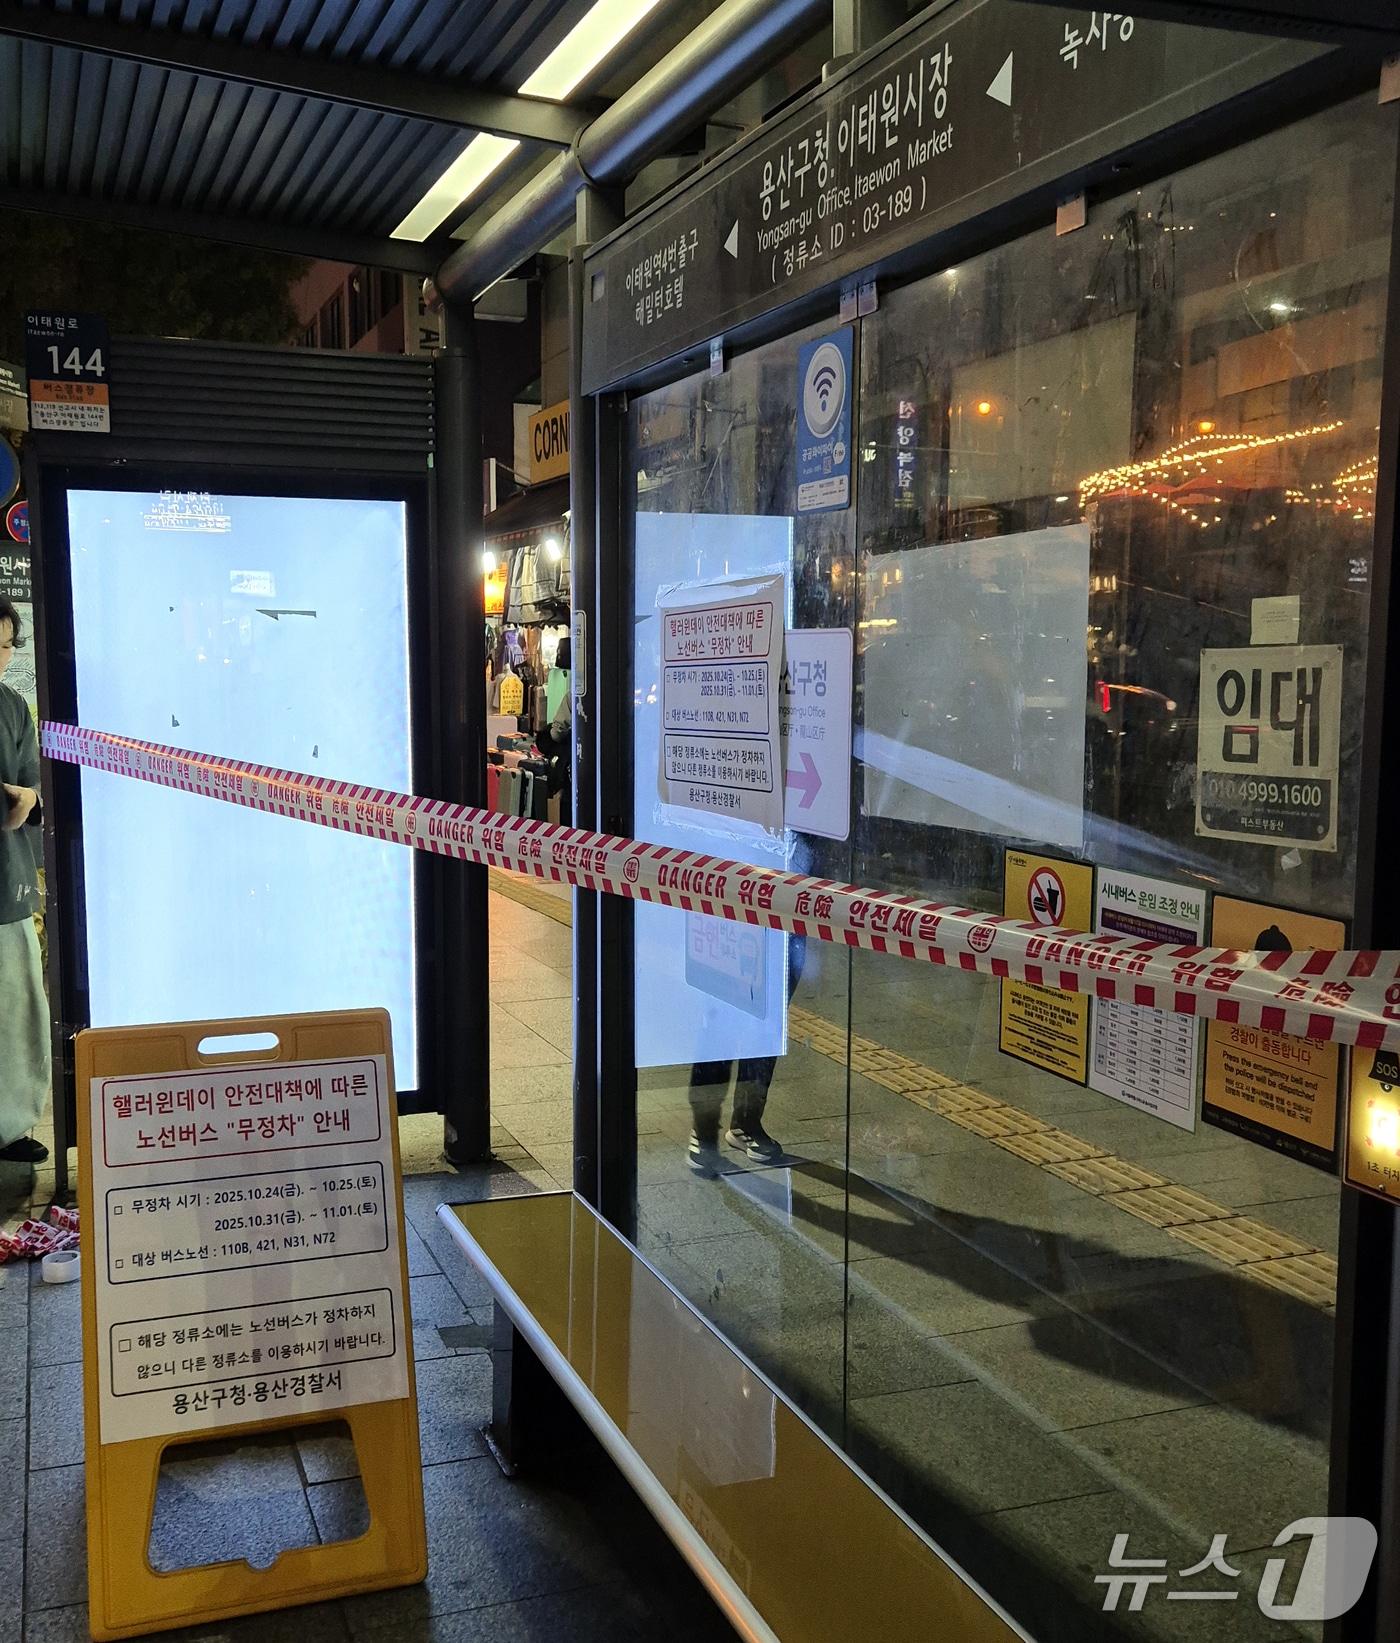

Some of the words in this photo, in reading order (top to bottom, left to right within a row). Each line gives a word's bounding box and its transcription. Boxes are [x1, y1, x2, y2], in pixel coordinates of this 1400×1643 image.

[756, 207, 813, 253] Yongsan-gu
[907, 123, 954, 171] Market
[783, 234, 823, 277] 정류소
[830, 222, 844, 250] ID
[863, 185, 912, 234] 03-189
[625, 228, 699, 296] 이태원역4번출구
[635, 273, 684, 327] 해밀턴호텔
[27, 315, 79, 330] 이태원로
[47, 346, 105, 377] 144
[746, 609, 764, 630] 따른
[677, 639, 705, 657] 노선버스
[737, 633, 754, 654] 안내
[779, 659, 827, 697] 산구청
[1216, 666, 1324, 767] 임대
[267, 787, 302, 805] DANGER
[306, 789, 324, 812] 위험
[355, 802, 396, 828] 안전제일
[428, 816, 474, 845] DANGER
[481, 828, 506, 853] 위험
[518, 835, 542, 859] 危險
[551, 841, 609, 875] 안전제일
[657, 864, 727, 899] DANGER
[738, 879, 777, 910] 위험
[794, 890, 835, 920] 危險
[848, 898, 943, 942] 안전제일
[1024, 933, 1154, 976] DANGER
[1170, 961, 1245, 992] 위험
[1273, 976, 1356, 1009] 危險
[1101, 882, 1137, 903] 시내버스
[1138, 891, 1157, 910] 운임
[1158, 896, 1178, 915] 조정
[1180, 900, 1200, 921] 안내
[1231, 1027, 1258, 1049] 경찰이
[1262, 1036, 1311, 1065] 출동합니다
[1222, 1050, 1240, 1063] Press
[1241, 1057, 1252, 1067] the
[1253, 1063, 1290, 1082] emergency
[1290, 1074, 1304, 1086] bell
[1304, 1080, 1319, 1091] and
[1224, 1062, 1235, 1073] the
[1235, 1068, 1255, 1081] police
[1255, 1074, 1267, 1084] will
[1267, 1078, 1277, 1088] be
[1376, 1061, 1398, 1079] SOS
[225, 1077, 323, 1108] 안전대책에
[331, 1073, 369, 1098] 따른
[136, 1122, 219, 1149] 노선버스
[227, 1113, 305, 1142] "무정차"
[313, 1107, 351, 1134] 안내
[1367, 1161, 1380, 1174] 1초
[131, 1196, 171, 1215] 무정차
[176, 1192, 202, 1209] 시기
[214, 1183, 305, 1205] 2025.10.24(금).
[322, 1175, 377, 1193] 10.25.(토)
[214, 1209, 306, 1232] 2025.10.31(금).
[322, 1201, 378, 1219] 11.01.(토)
[132, 1251, 156, 1268] 대상
[161, 1245, 209, 1264] 버스노선
[220, 1243, 253, 1258] 110B,
[256, 1238, 280, 1253] 421,
[283, 1235, 309, 1249] N31,
[313, 1231, 336, 1245] N72
[138, 1332, 168, 1350] 해당
[172, 1323, 245, 1345] 정류소에는
[249, 1312, 318, 1335] 노선버스가
[322, 1303, 376, 1324] 정차하지
[137, 1360, 176, 1380] 않으니
[181, 1357, 207, 1374] 다른
[212, 1349, 263, 1370] 정류소를
[267, 1339, 330, 1361] 이용하시기
[334, 1331, 385, 1351] 바랍니다.
[171, 1370, 343, 1415] 용산구청·용산경찰서
